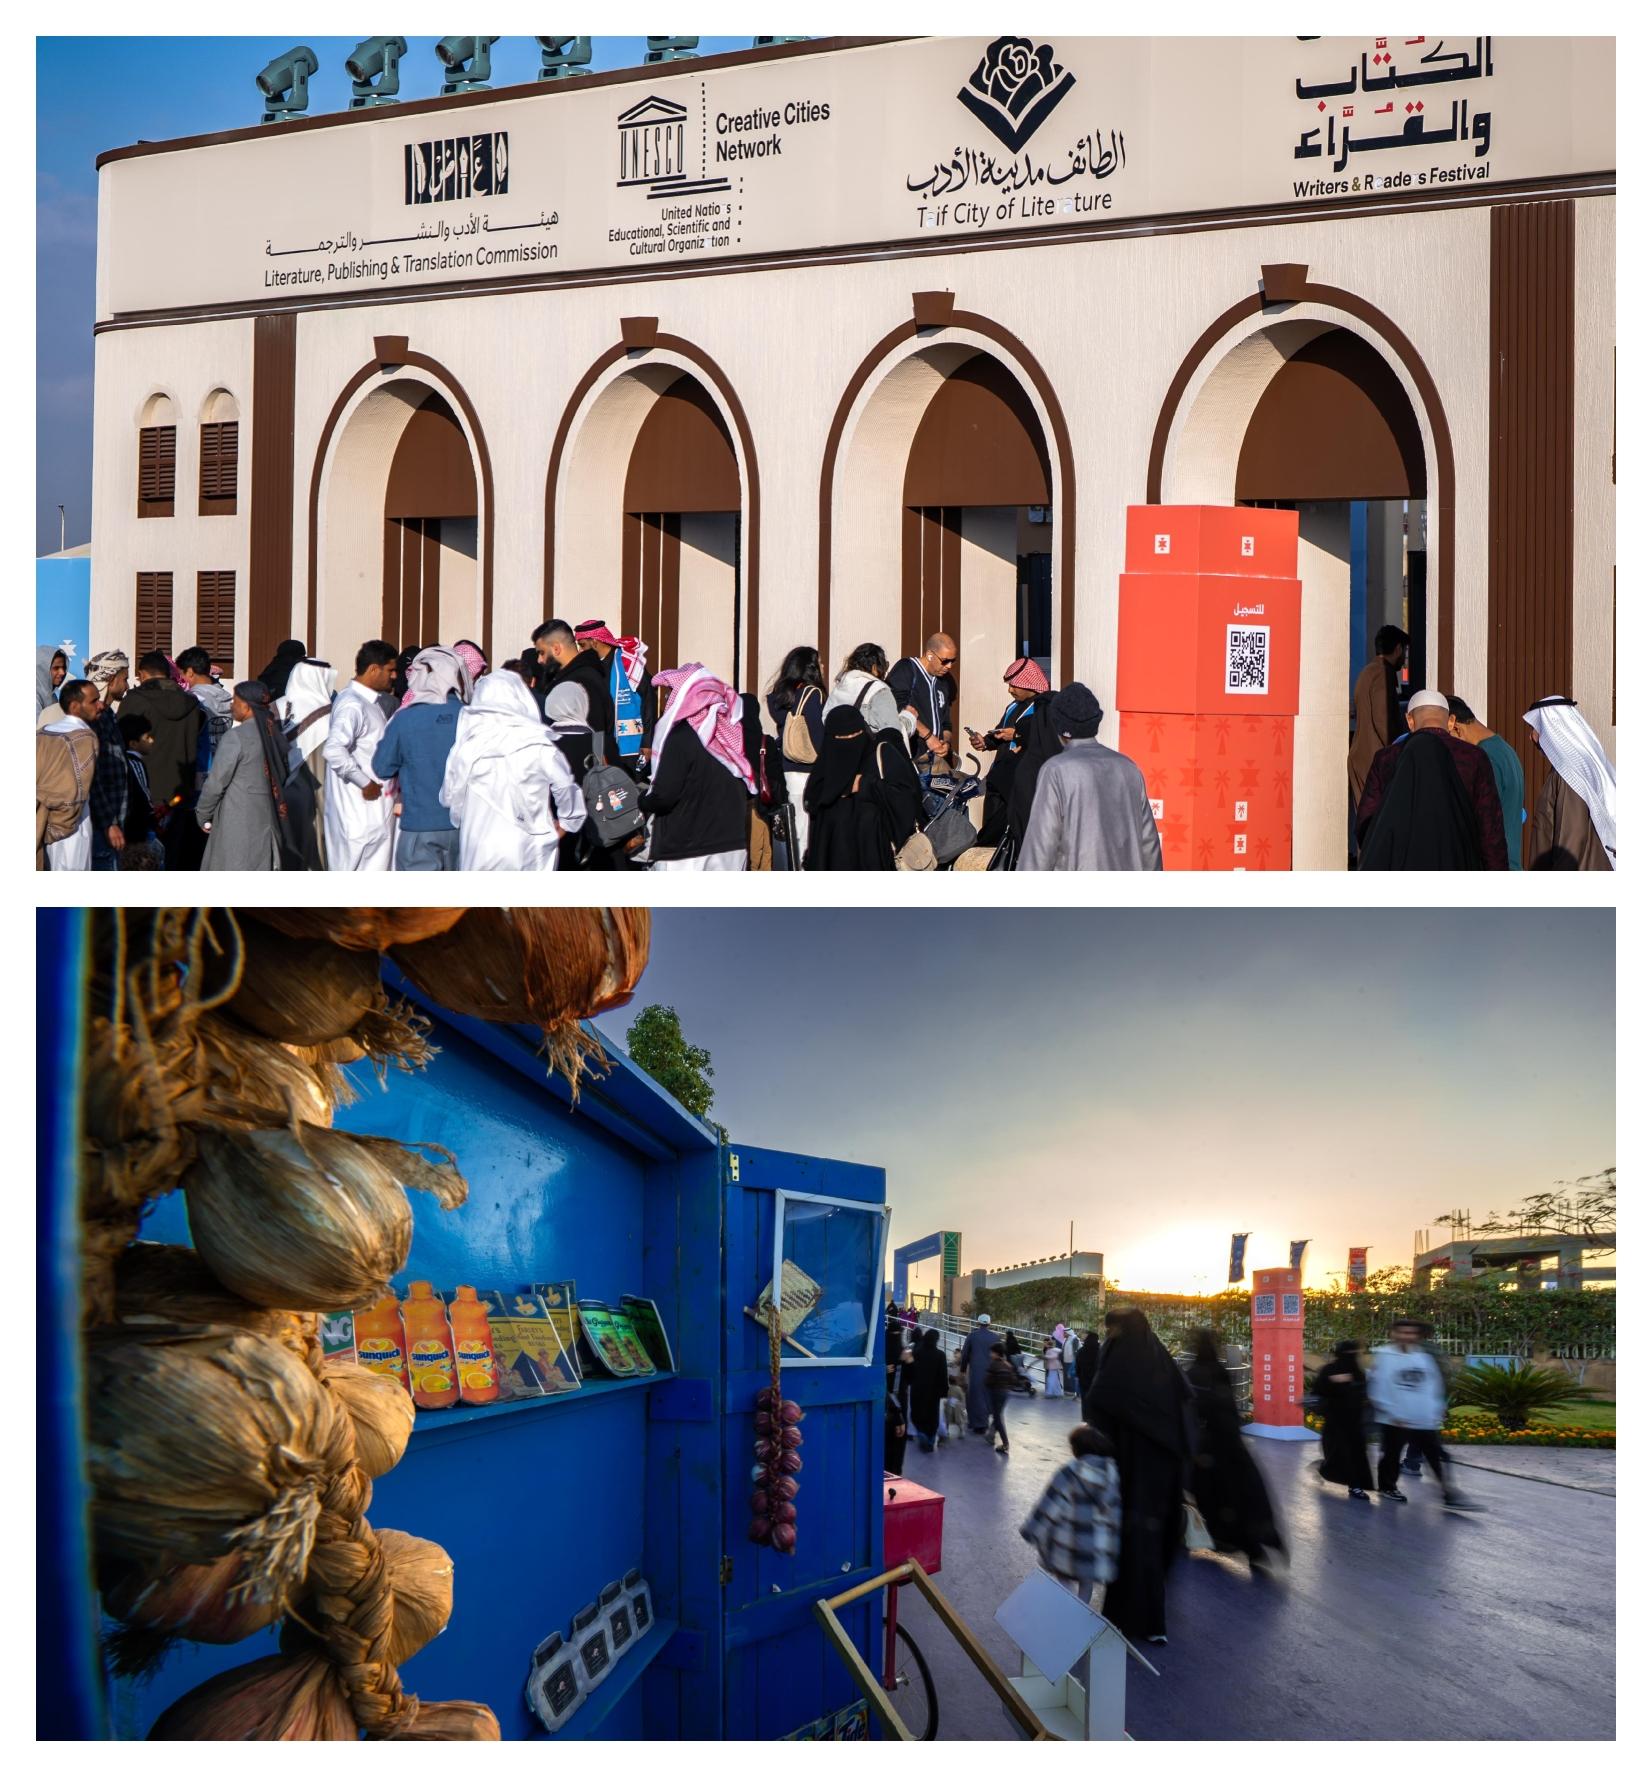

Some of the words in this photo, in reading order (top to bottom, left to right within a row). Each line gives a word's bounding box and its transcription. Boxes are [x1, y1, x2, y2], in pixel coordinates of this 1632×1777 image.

[716, 107, 781, 134] Creative
[784, 100, 830, 125] Cities
[620, 124, 684, 180] UNESCO
[716, 134, 782, 162] Network
[1048, 128, 1126, 186] الطائف
[980, 151, 1044, 195] مدينة
[1293, 180, 1349, 198] Writers
[1351, 177, 1361, 191] &
[1364, 171, 1427, 190] Rades
[1430, 162, 1490, 184] Festival
[482, 211, 559, 232] هيئة
[662, 205, 692, 221] United
[694, 201, 732, 217] Natios
[954, 202, 990, 228] City
[996, 197, 1015, 219] of
[1021, 192, 1112, 218] Liteture
[359, 220, 449, 249] والنشر
[452, 212, 480, 238] الأدب
[608, 224, 664, 242] Educational,
[667, 219, 710, 237] Scientific
[712, 217, 731, 232] and
[265, 231, 357, 256] والترجمة
[630, 239, 666, 256] Cultural
[668, 234, 730, 254] Organiztion
[264, 263, 325, 287] Literature,
[327, 257, 388, 281] Publishing
[391, 259, 400, 273] &
[403, 251, 473, 273] Translation
[476, 242, 558, 266] Commission
[1233, 603, 1265, 617] للتسجيل
